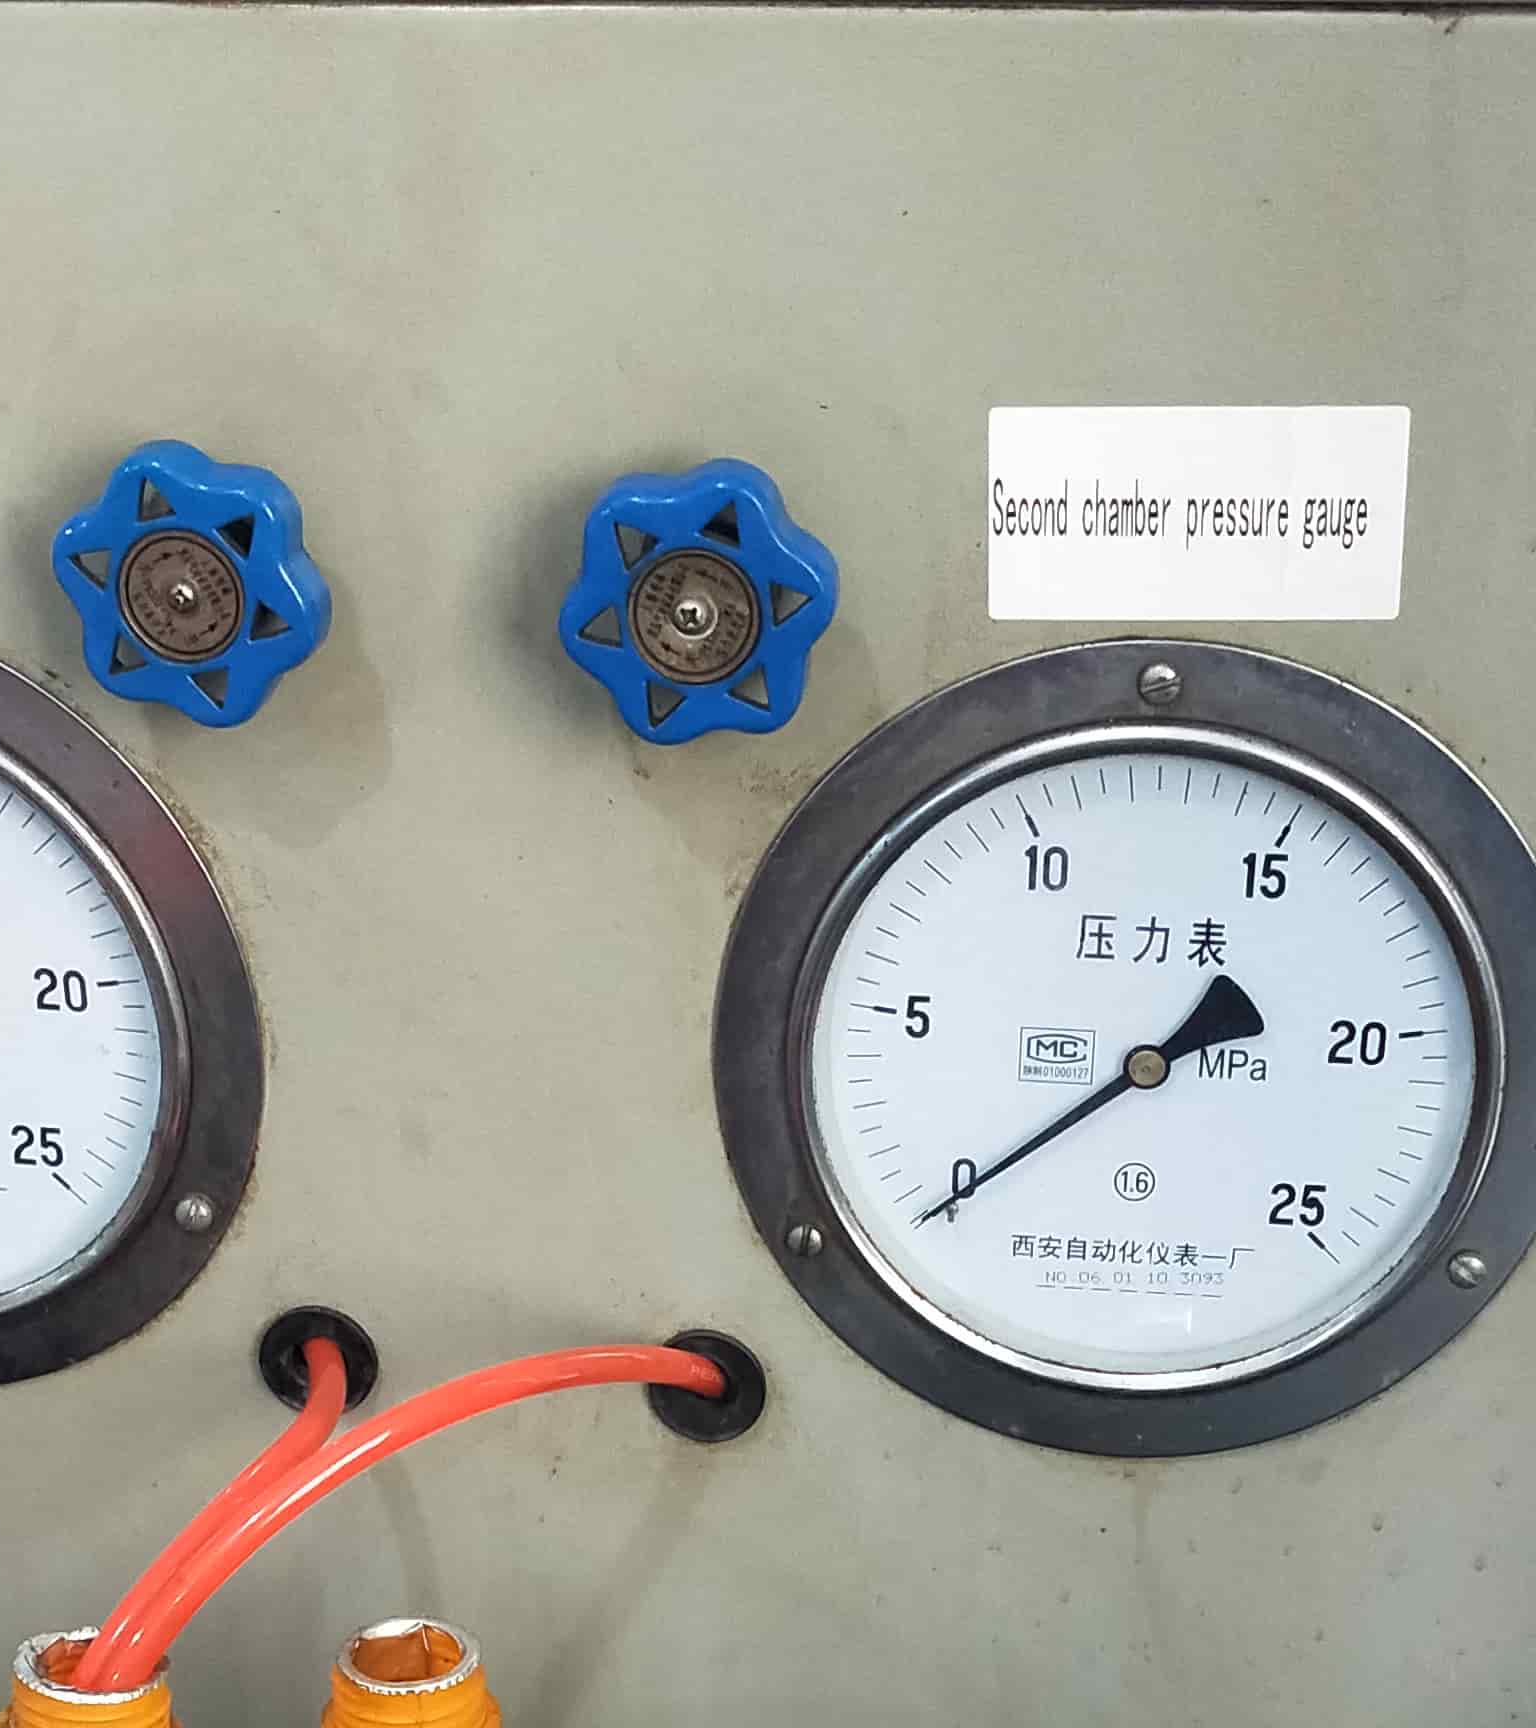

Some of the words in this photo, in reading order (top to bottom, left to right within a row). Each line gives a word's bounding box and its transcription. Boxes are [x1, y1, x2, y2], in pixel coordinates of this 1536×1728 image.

[992, 478, 1068, 537] Second
[1082, 478, 1171, 537] chamber
[1186, 497, 1289, 550] pressure
[1302, 497, 1368, 549] gauge
[1024, 846, 1070, 892] 10
[1242, 855, 1288, 899] 15
[1076, 913, 1229, 968] 压力表
[33, 970, 89, 1013] 20
[904, 997, 931, 1039] 5
[1326, 1019, 1386, 1066] 20
[1198, 1049, 1267, 1081] MPa
[10, 1124, 63, 1168] 25
[950, 1158, 979, 1201] 0
[1120, 1170, 1149, 1194] 1.6
[1267, 1183, 1329, 1228] 25
[1011, 1234, 1256, 1269] 西安自动化仪表一厂
